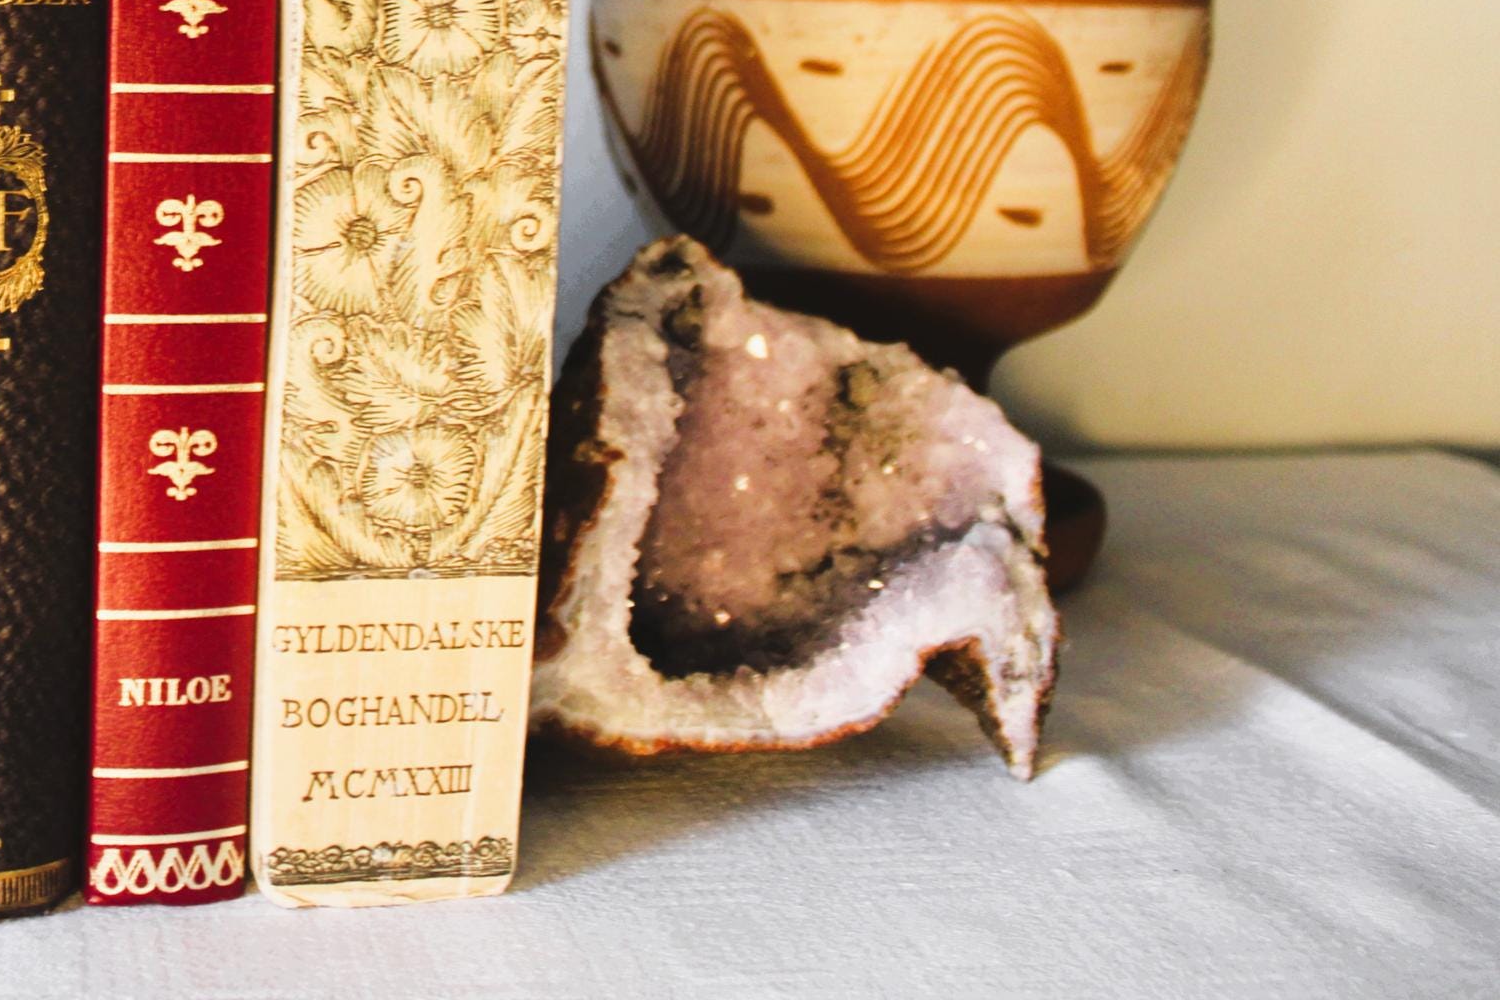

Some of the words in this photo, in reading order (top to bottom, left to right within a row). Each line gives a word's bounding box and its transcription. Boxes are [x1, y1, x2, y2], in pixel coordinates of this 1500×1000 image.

[272, 620, 526, 654] GYLDENDALSKE
[117, 674, 232, 707] NILOE
[281, 691, 505, 729] BOGHANDEL
[302, 764, 473, 803] MCMXXIII
